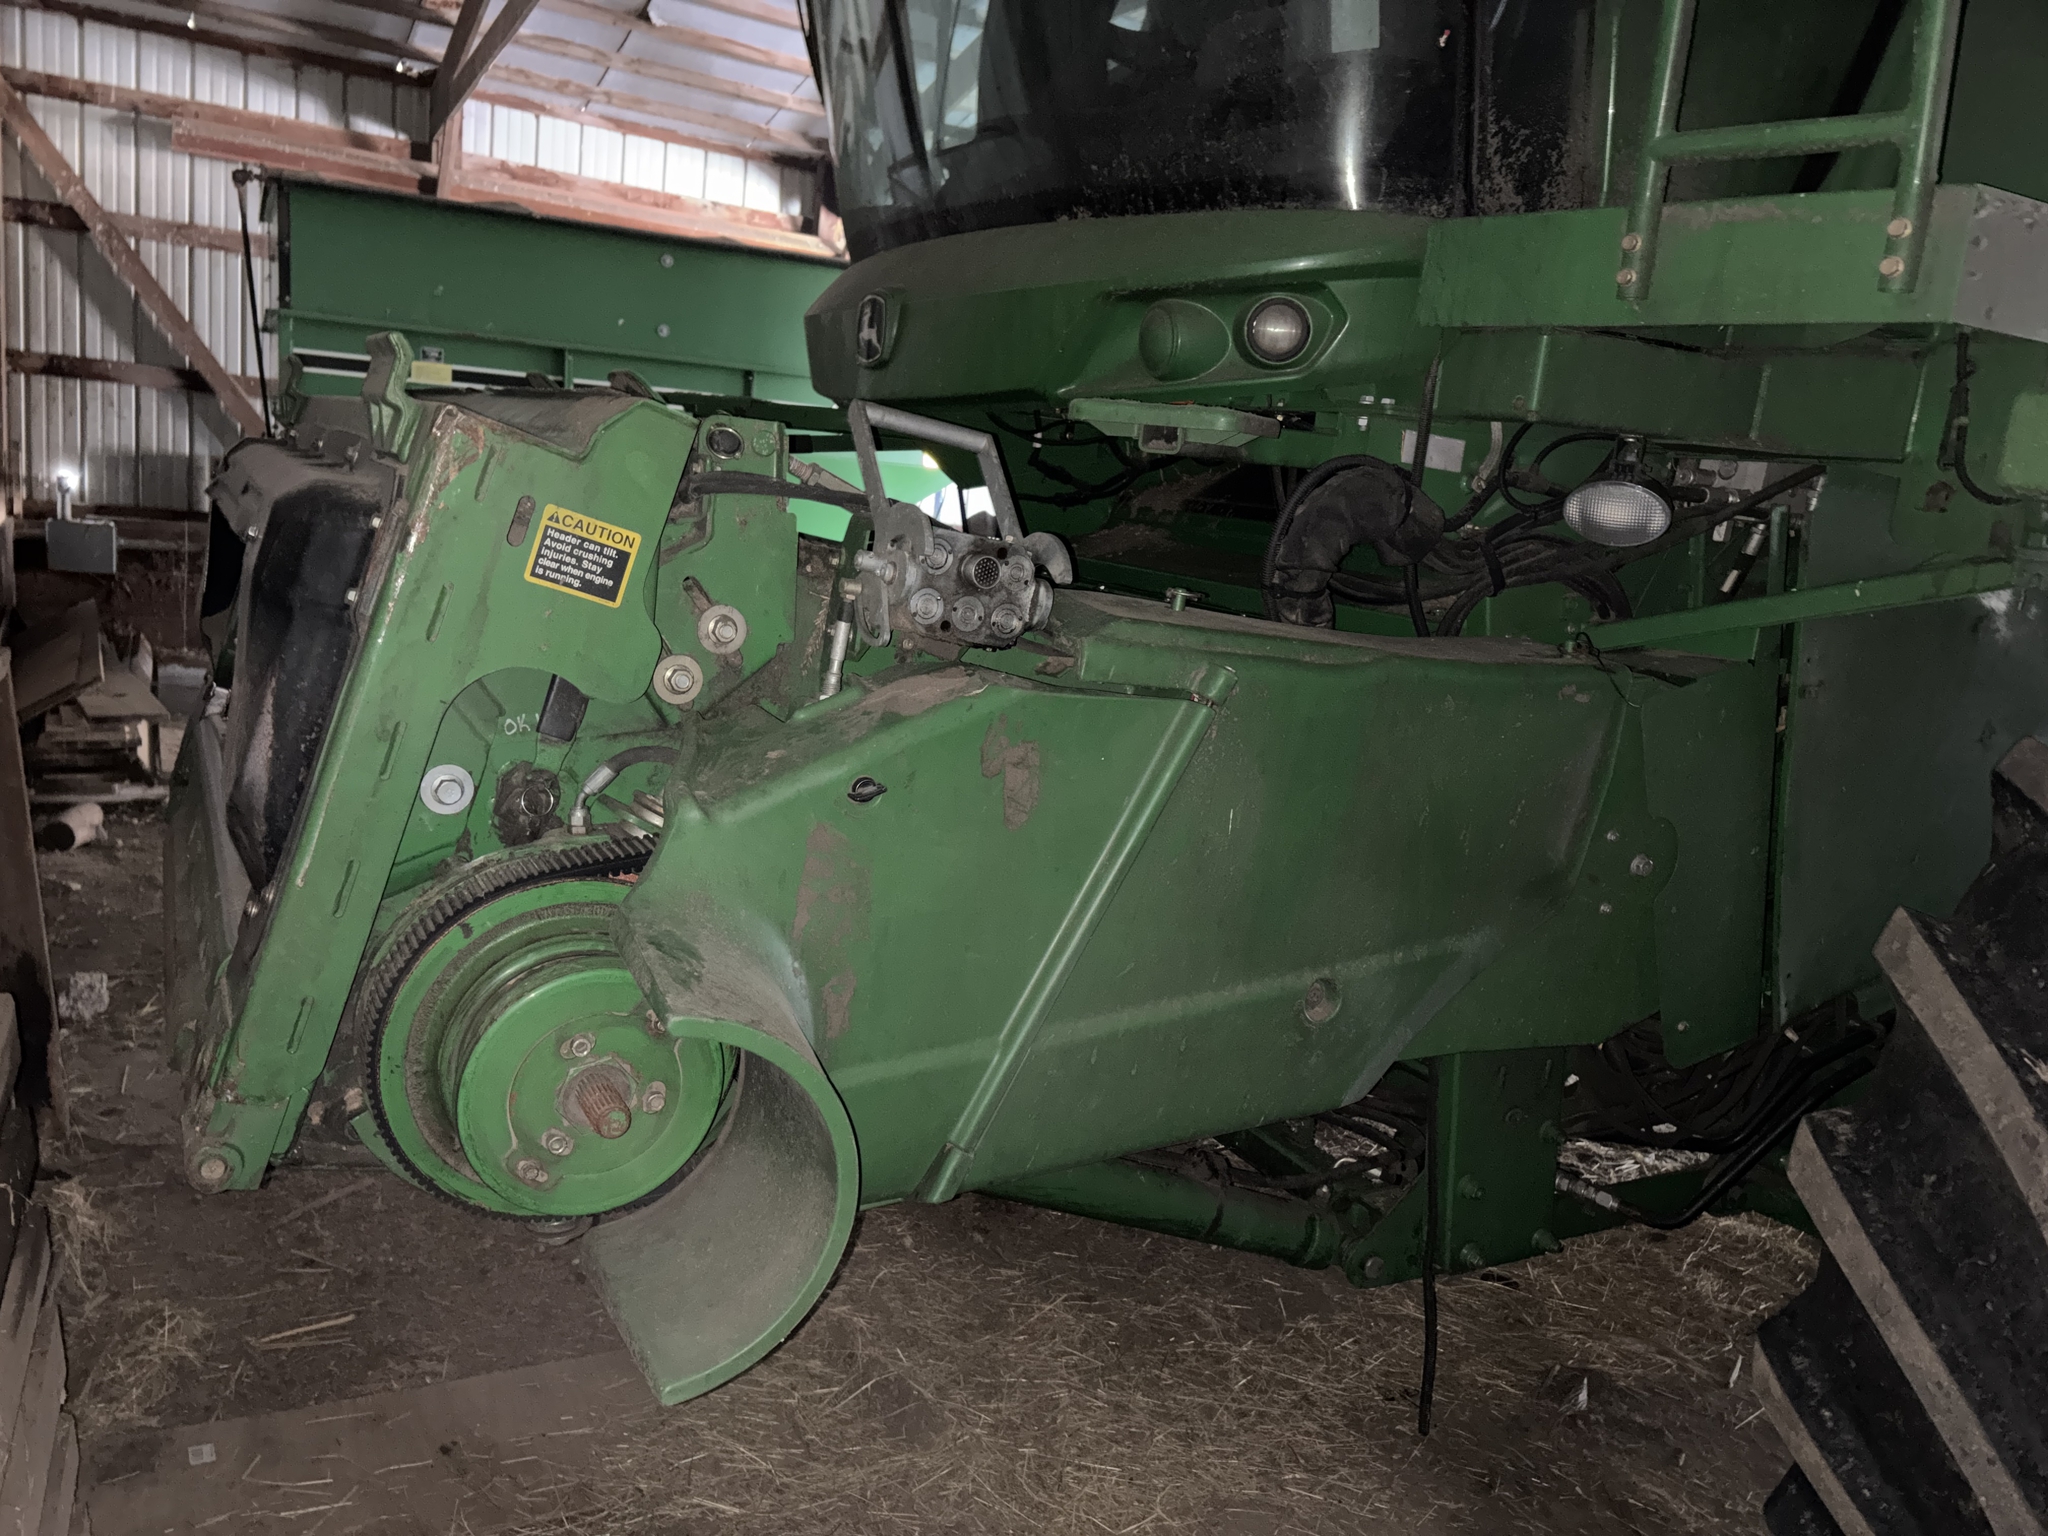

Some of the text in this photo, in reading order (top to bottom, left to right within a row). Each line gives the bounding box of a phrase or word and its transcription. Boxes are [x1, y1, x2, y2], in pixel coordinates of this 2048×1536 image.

[546, 528, 619, 559] Header can tilt.
[562, 515, 636, 549] CAUTION
[544, 538, 614, 568] Avoid crushing
[582, 560, 603, 575] Stay
[535, 565, 582, 587] is running.
[538, 557, 614, 587] clear when engine
